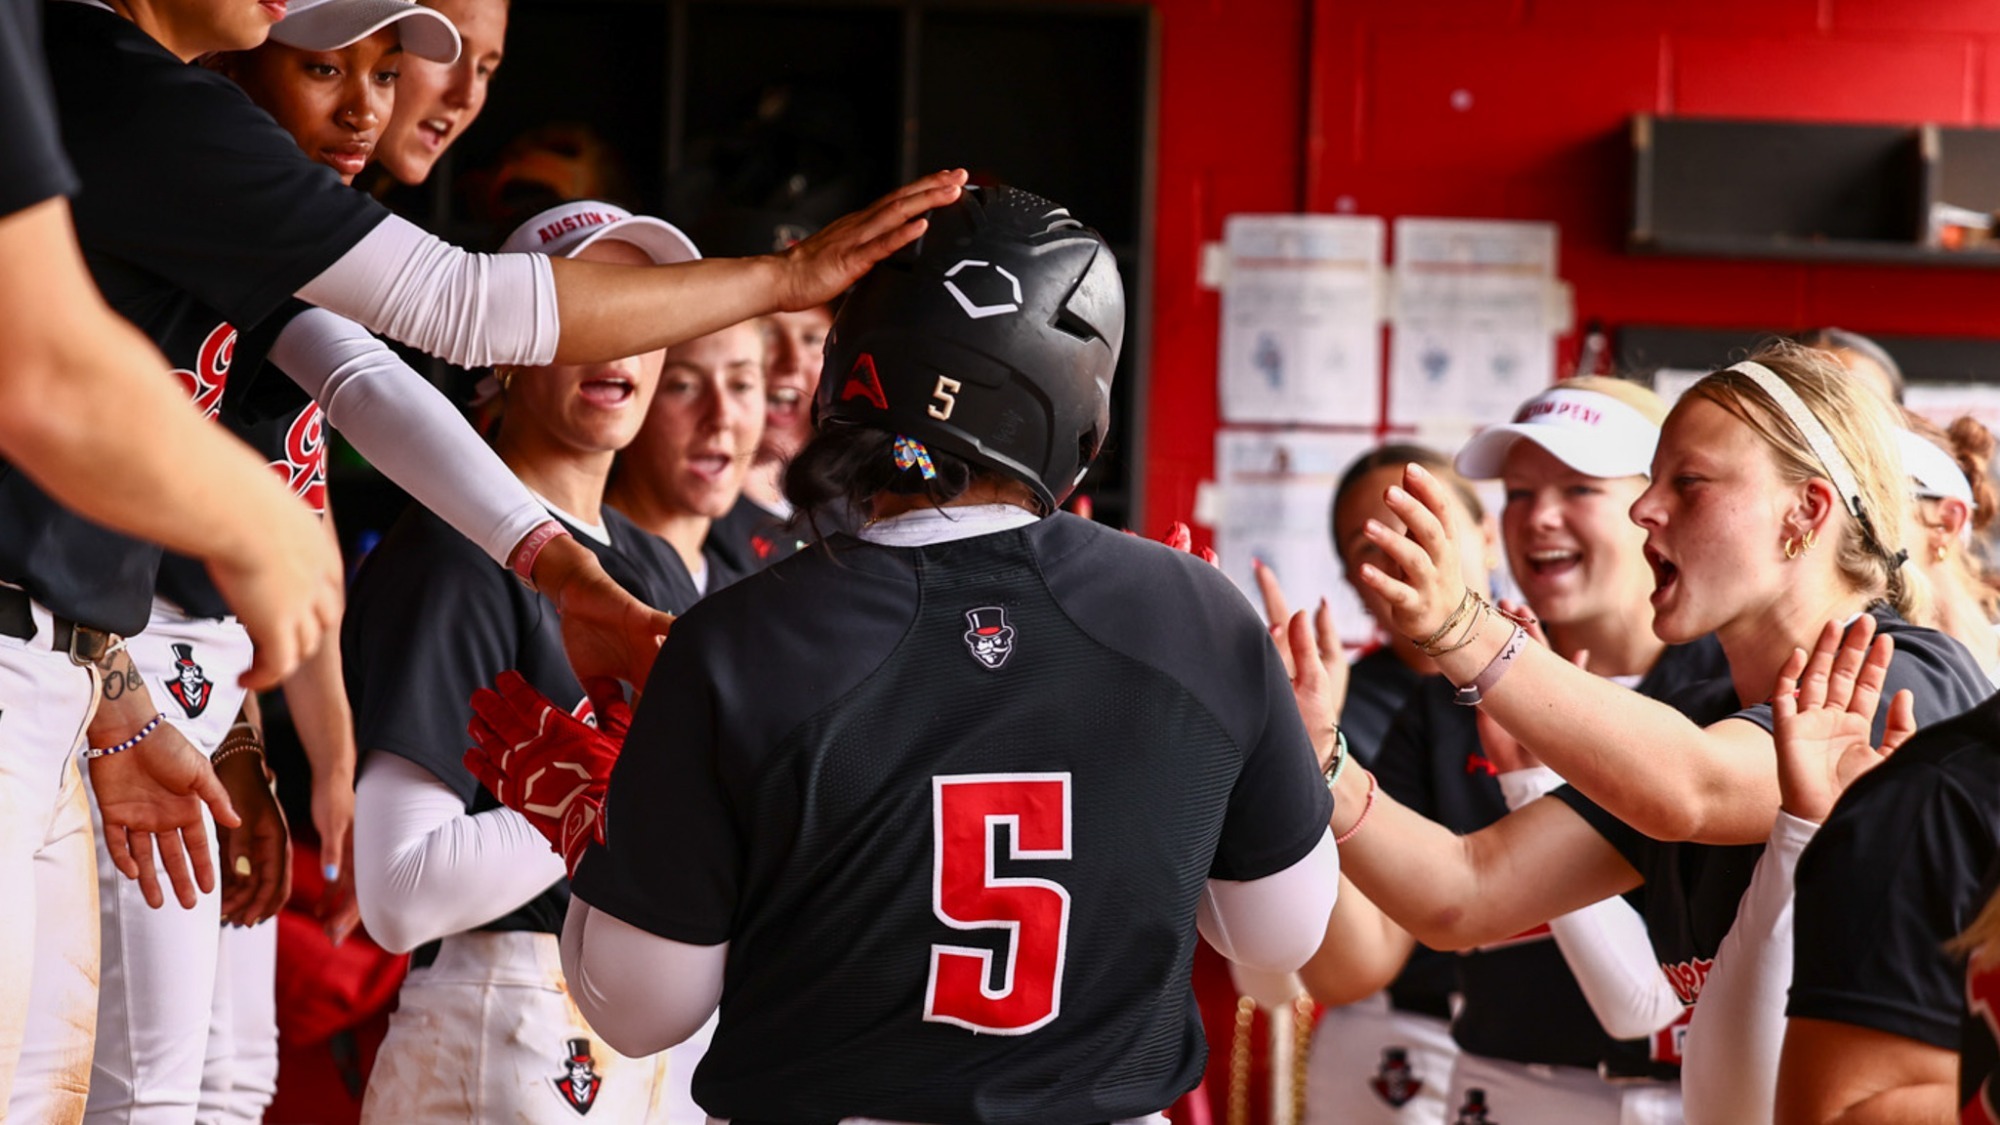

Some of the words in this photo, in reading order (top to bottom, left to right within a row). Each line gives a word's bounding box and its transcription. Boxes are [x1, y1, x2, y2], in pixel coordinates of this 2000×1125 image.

[537, 211, 604, 244] AUSTIN
[927, 374, 962, 421] 5
[922, 771, 1073, 1037] 5
